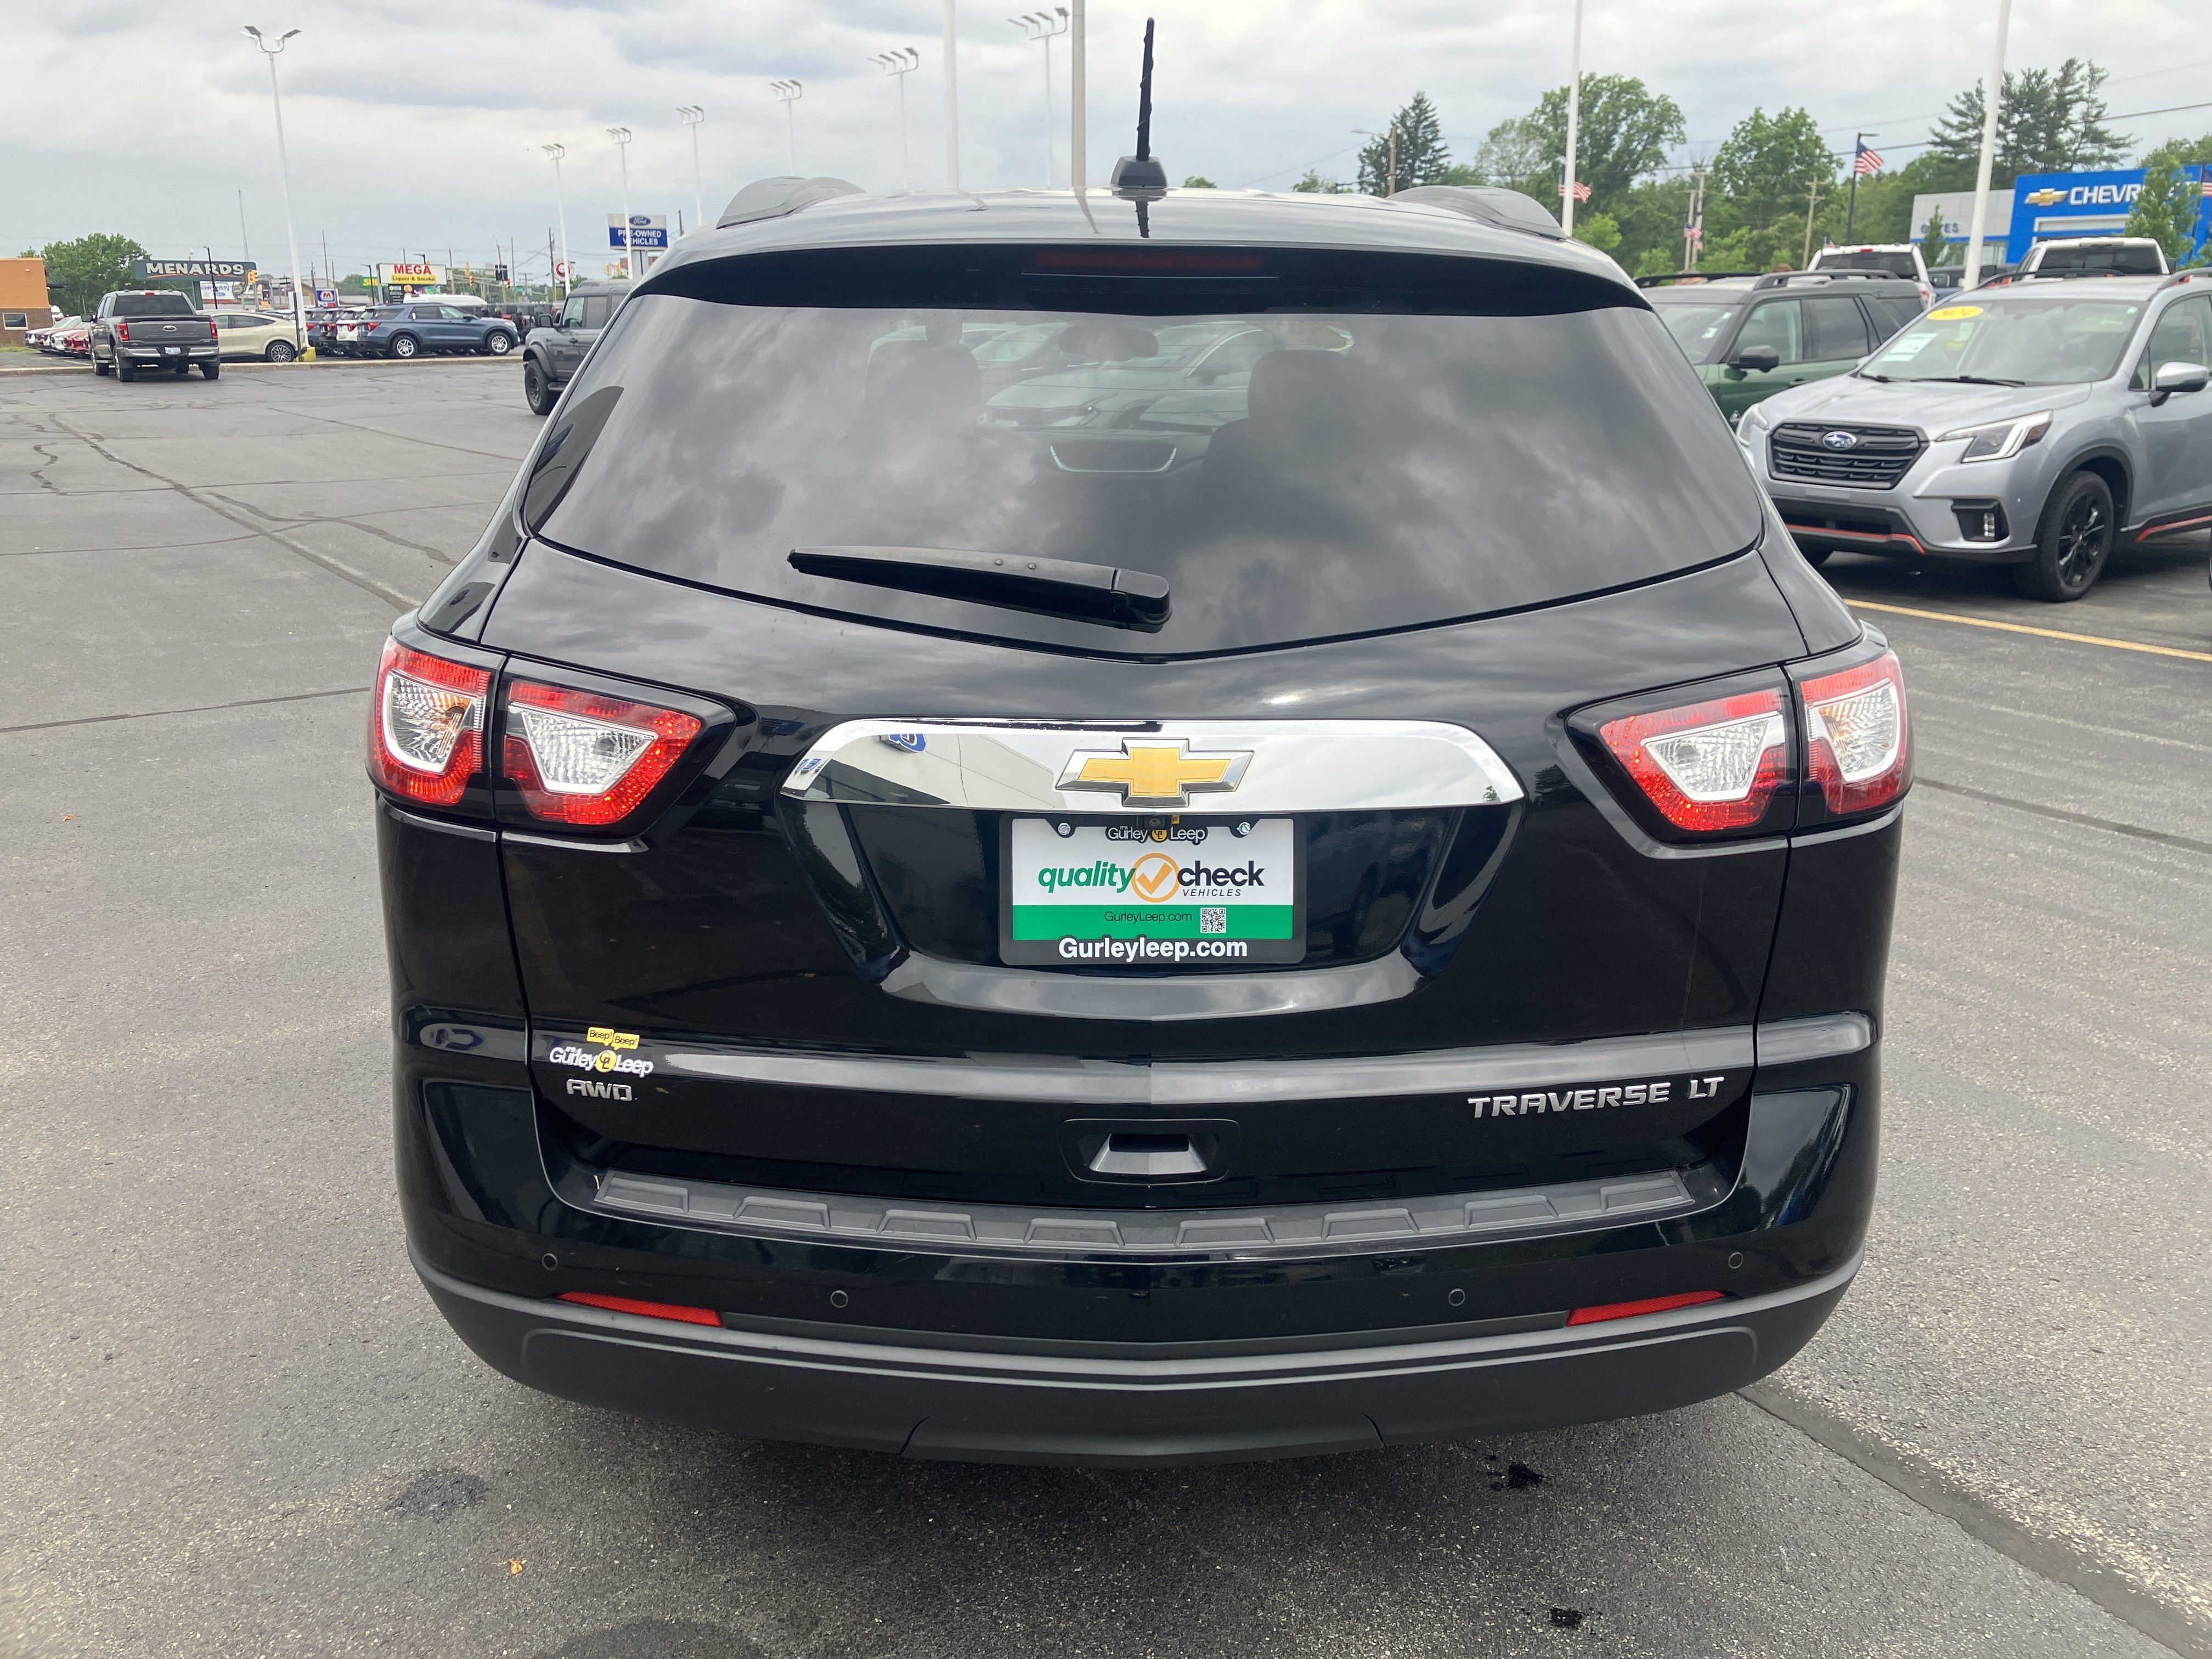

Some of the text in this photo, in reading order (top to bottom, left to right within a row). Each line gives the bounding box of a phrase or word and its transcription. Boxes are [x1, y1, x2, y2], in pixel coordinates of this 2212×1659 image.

[2070, 184, 2146, 206] CHEVR
[1921, 223, 1959, 234] GES
[623, 237, 658, 245] VHICLES
[146, 263, 244, 275] MENARDS
[394, 263, 431, 274] MEGA
[1108, 827, 1148, 842] Gurley
[1171, 828, 1205, 843] Leep
[1038, 860, 1265, 893] quality check
[1183, 889, 1242, 897] VEHICLES
[1104, 911, 1192, 924] GurleyLeep.com
[1058, 937, 1248, 963] Gurleyleep.com
[589, 1030, 612, 1040] Beep!
[614, 1036, 637, 1046] Beep!
[613, 1054, 654, 1078] Leep
[566, 1079, 633, 1101] AWD
[1468, 1076, 1725, 1119] TRAVERSE LT
